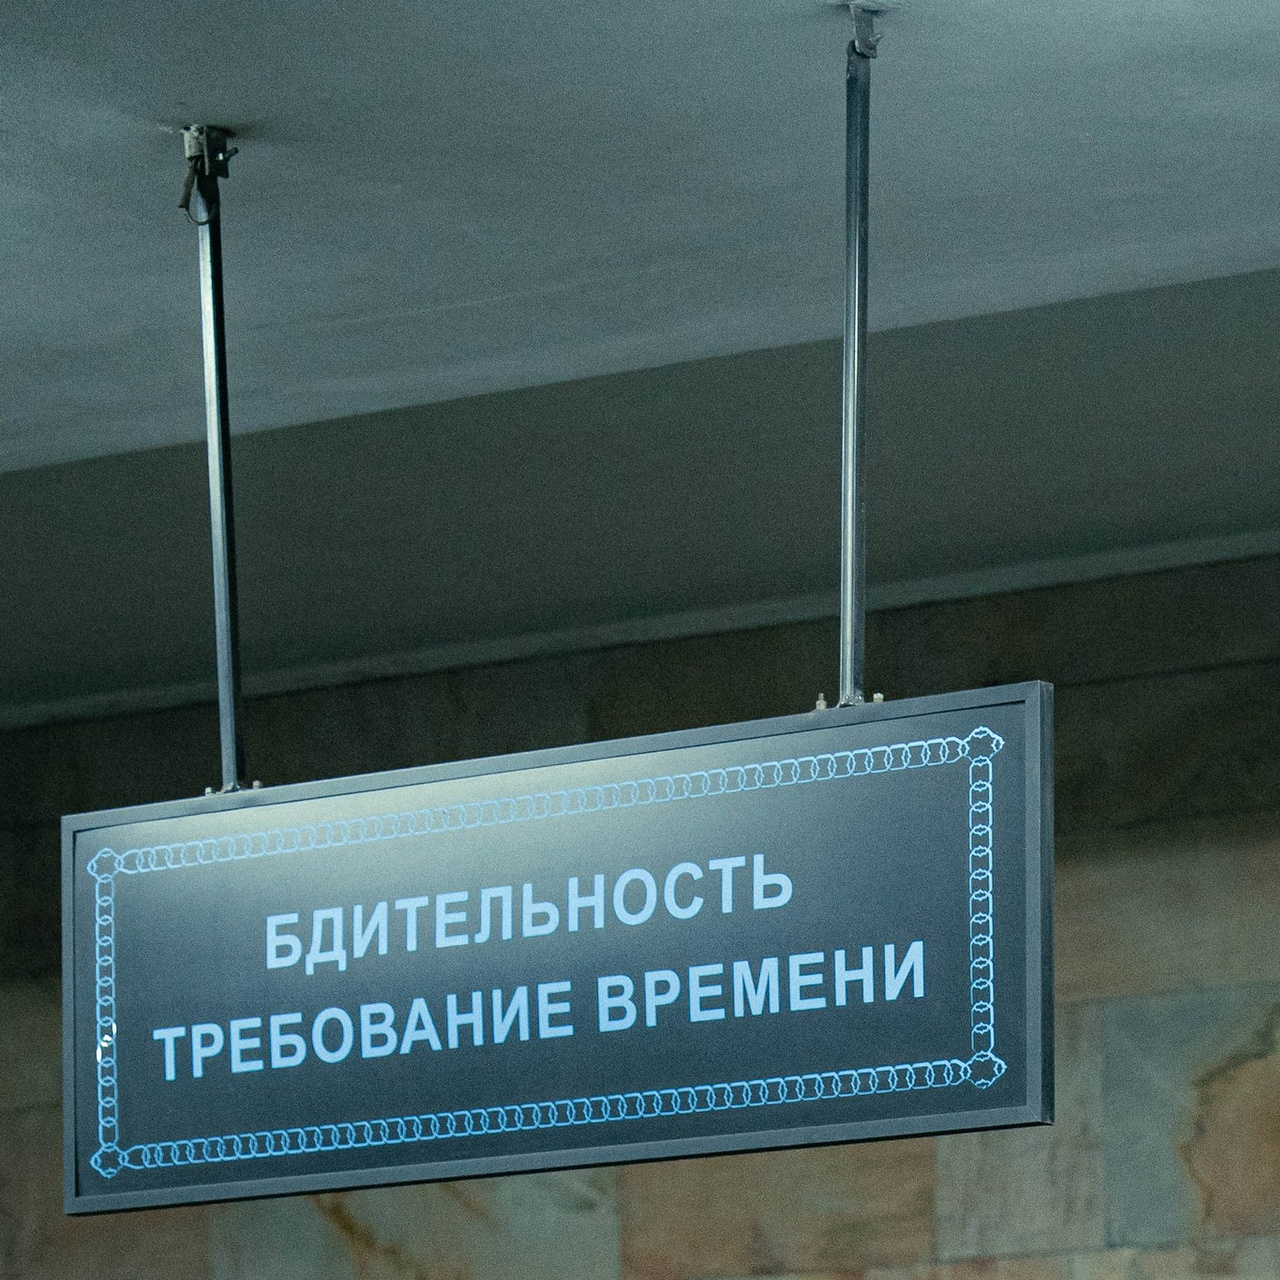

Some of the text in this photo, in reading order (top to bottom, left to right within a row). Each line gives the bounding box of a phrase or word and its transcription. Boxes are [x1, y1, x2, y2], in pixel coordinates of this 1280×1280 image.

[265, 853, 794, 975] БДИТЕЛЬНОСТЬ
[152, 940, 926, 1082] ТРЕБОВАНИЕ ВРЕМЕНИ
